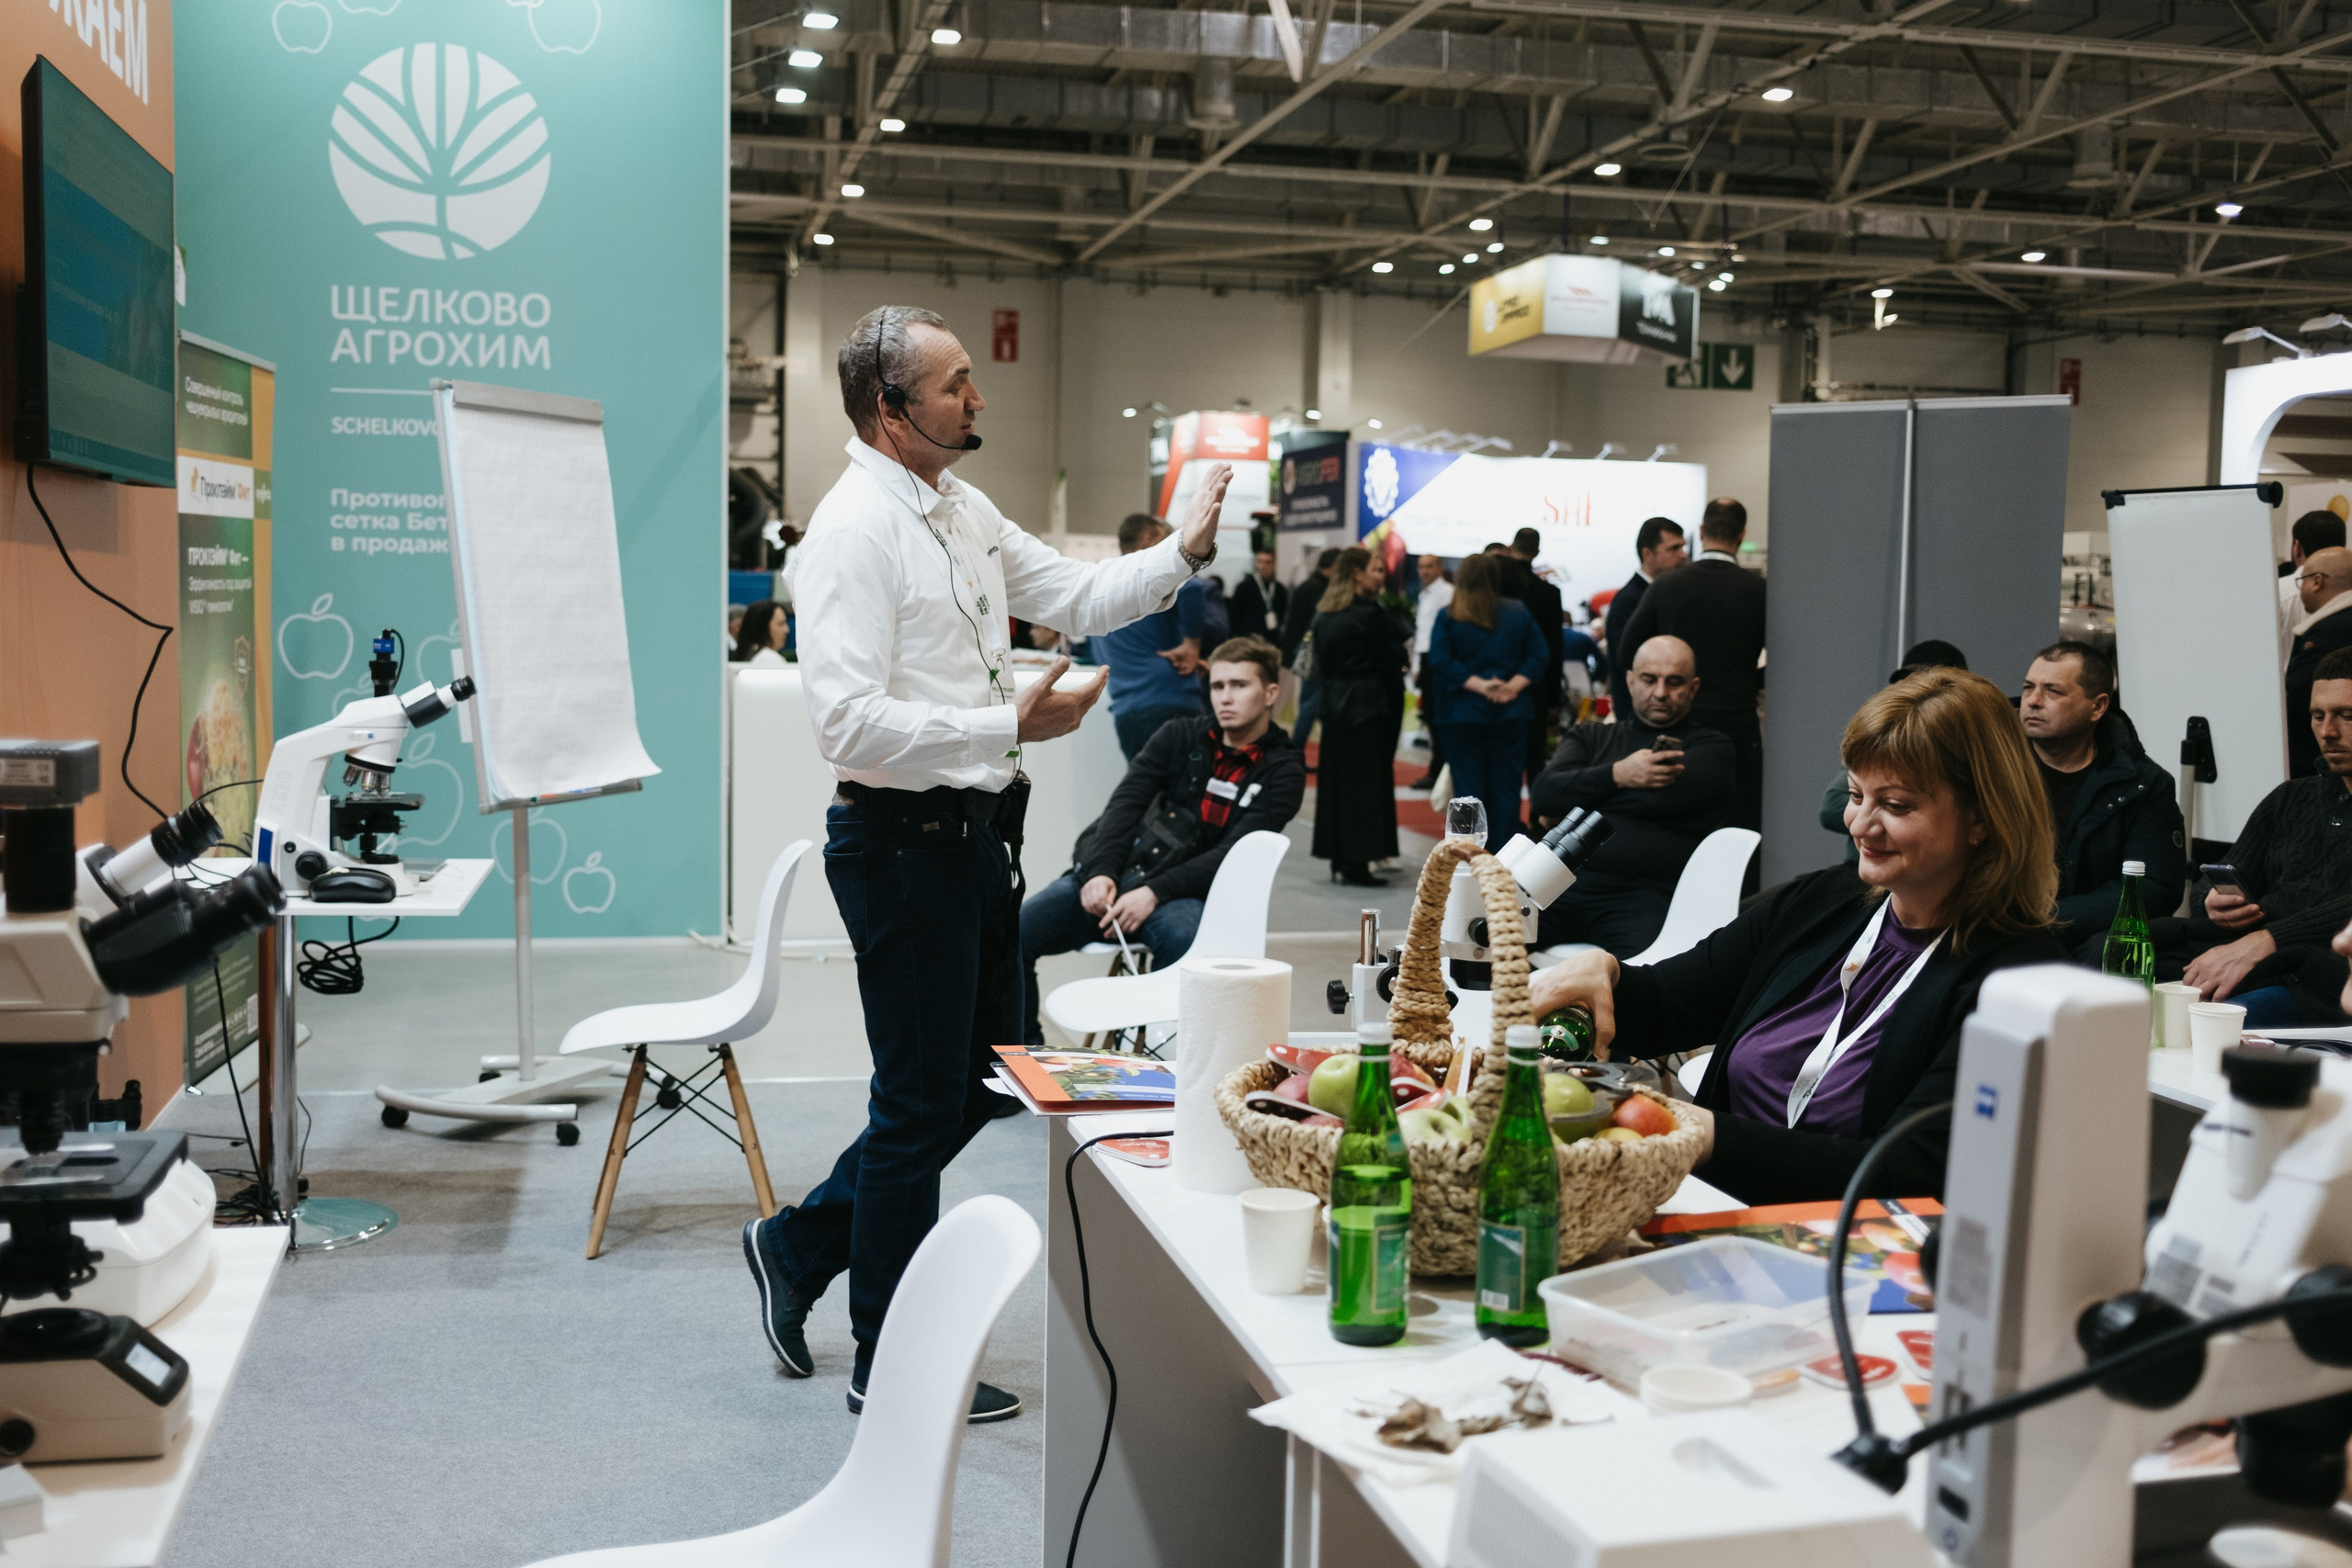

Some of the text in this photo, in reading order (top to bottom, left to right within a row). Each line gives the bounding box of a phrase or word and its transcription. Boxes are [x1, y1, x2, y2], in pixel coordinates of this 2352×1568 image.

[331, 285, 551, 328] ЩЕЛКОВО
[330, 328, 551, 370] АГРОХИМ
[330, 513, 400, 531] сетка
[331, 536, 345, 551] в
